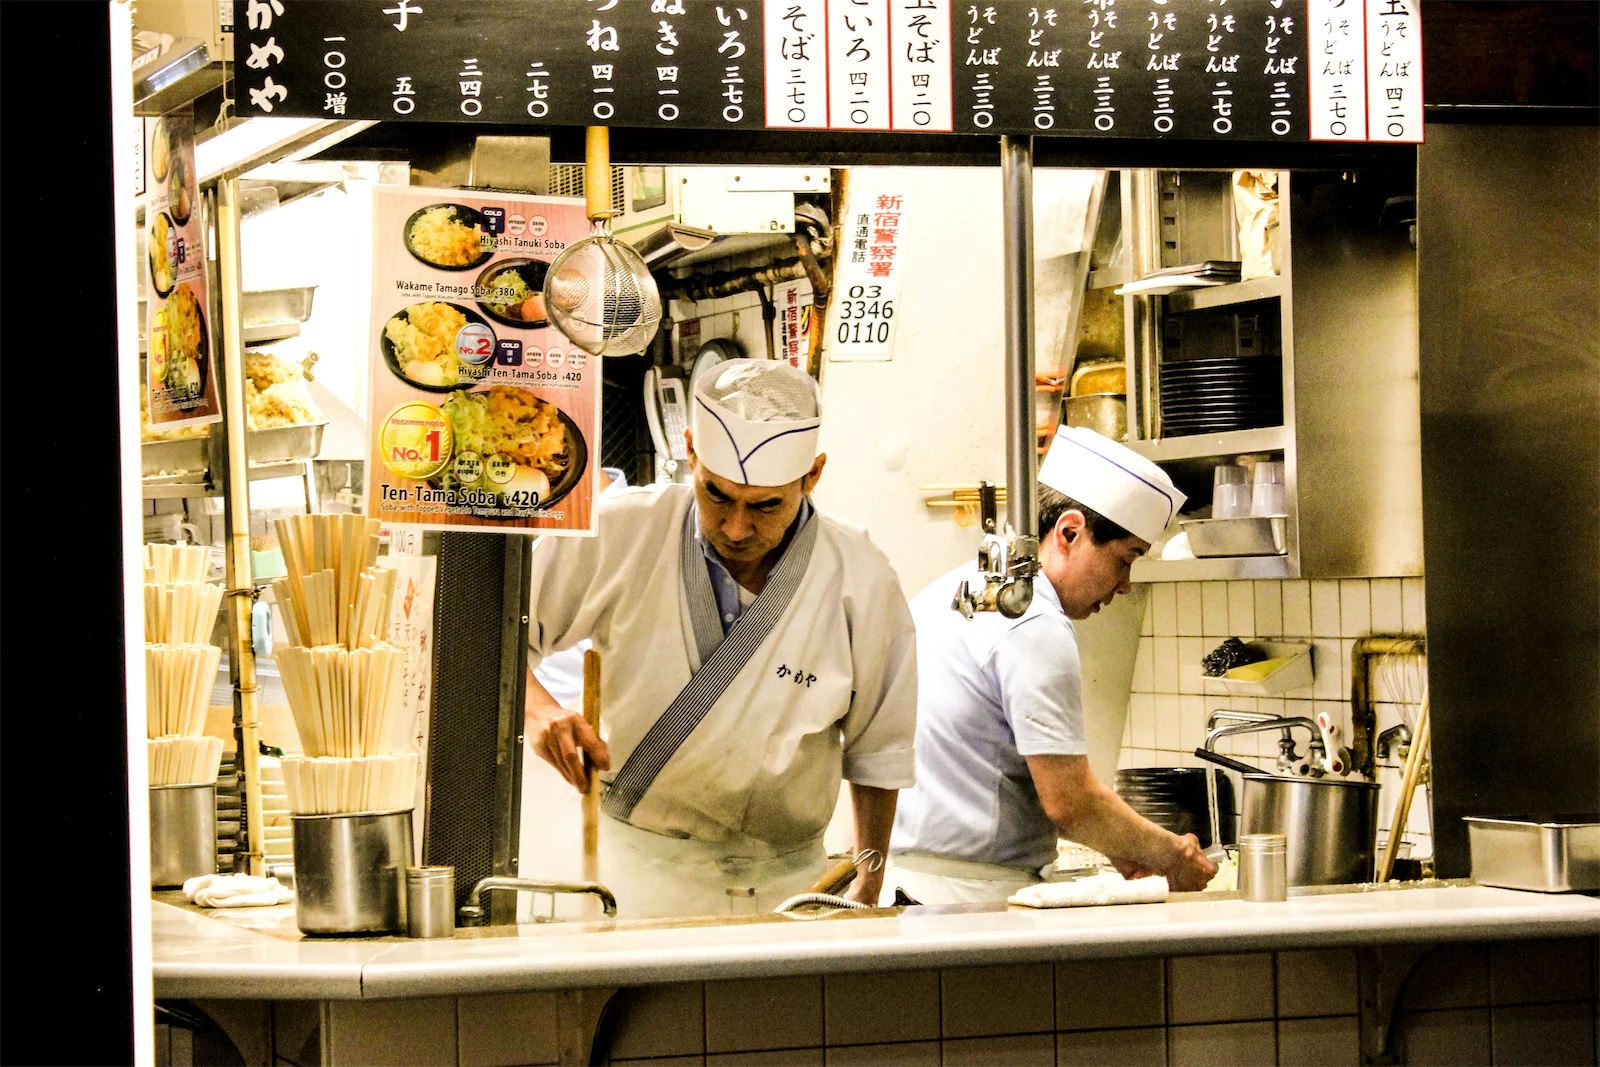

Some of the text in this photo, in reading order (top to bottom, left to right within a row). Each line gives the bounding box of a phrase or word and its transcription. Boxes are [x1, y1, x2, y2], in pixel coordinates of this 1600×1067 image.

[381, 0, 424, 32] 子
[715, 6, 749, 59] いろ
[780, 5, 816, 61] そば
[844, 0, 873, 63] いろ
[245, 0, 288, 113] かめや
[483, 209, 503, 217] COLD
[480, 235, 565, 250] Hiyashi Tanuki Soba
[851, 213, 871, 263] 直通電話
[867, 194, 904, 277] 新宿警察署
[396, 280, 433, 292] Wakame
[435, 282, 468, 296] Tamago
[470, 285, 492, 296] Soba
[848, 285, 883, 299] 03
[840, 300, 894, 320] 3346
[837, 321, 890, 344] 0110
[459, 338, 491, 355] No.2
[458, 366, 490, 378] Hiyashi
[492, 367, 535, 379] Ten-Tama
[536, 370, 557, 380] Soba
[392, 430, 441, 462] No.1
[381, 484, 540, 507] Ten-Tama Soba ¥420
[416, 504, 439, 514] Topped
[776, 663, 817, 688] かめや
